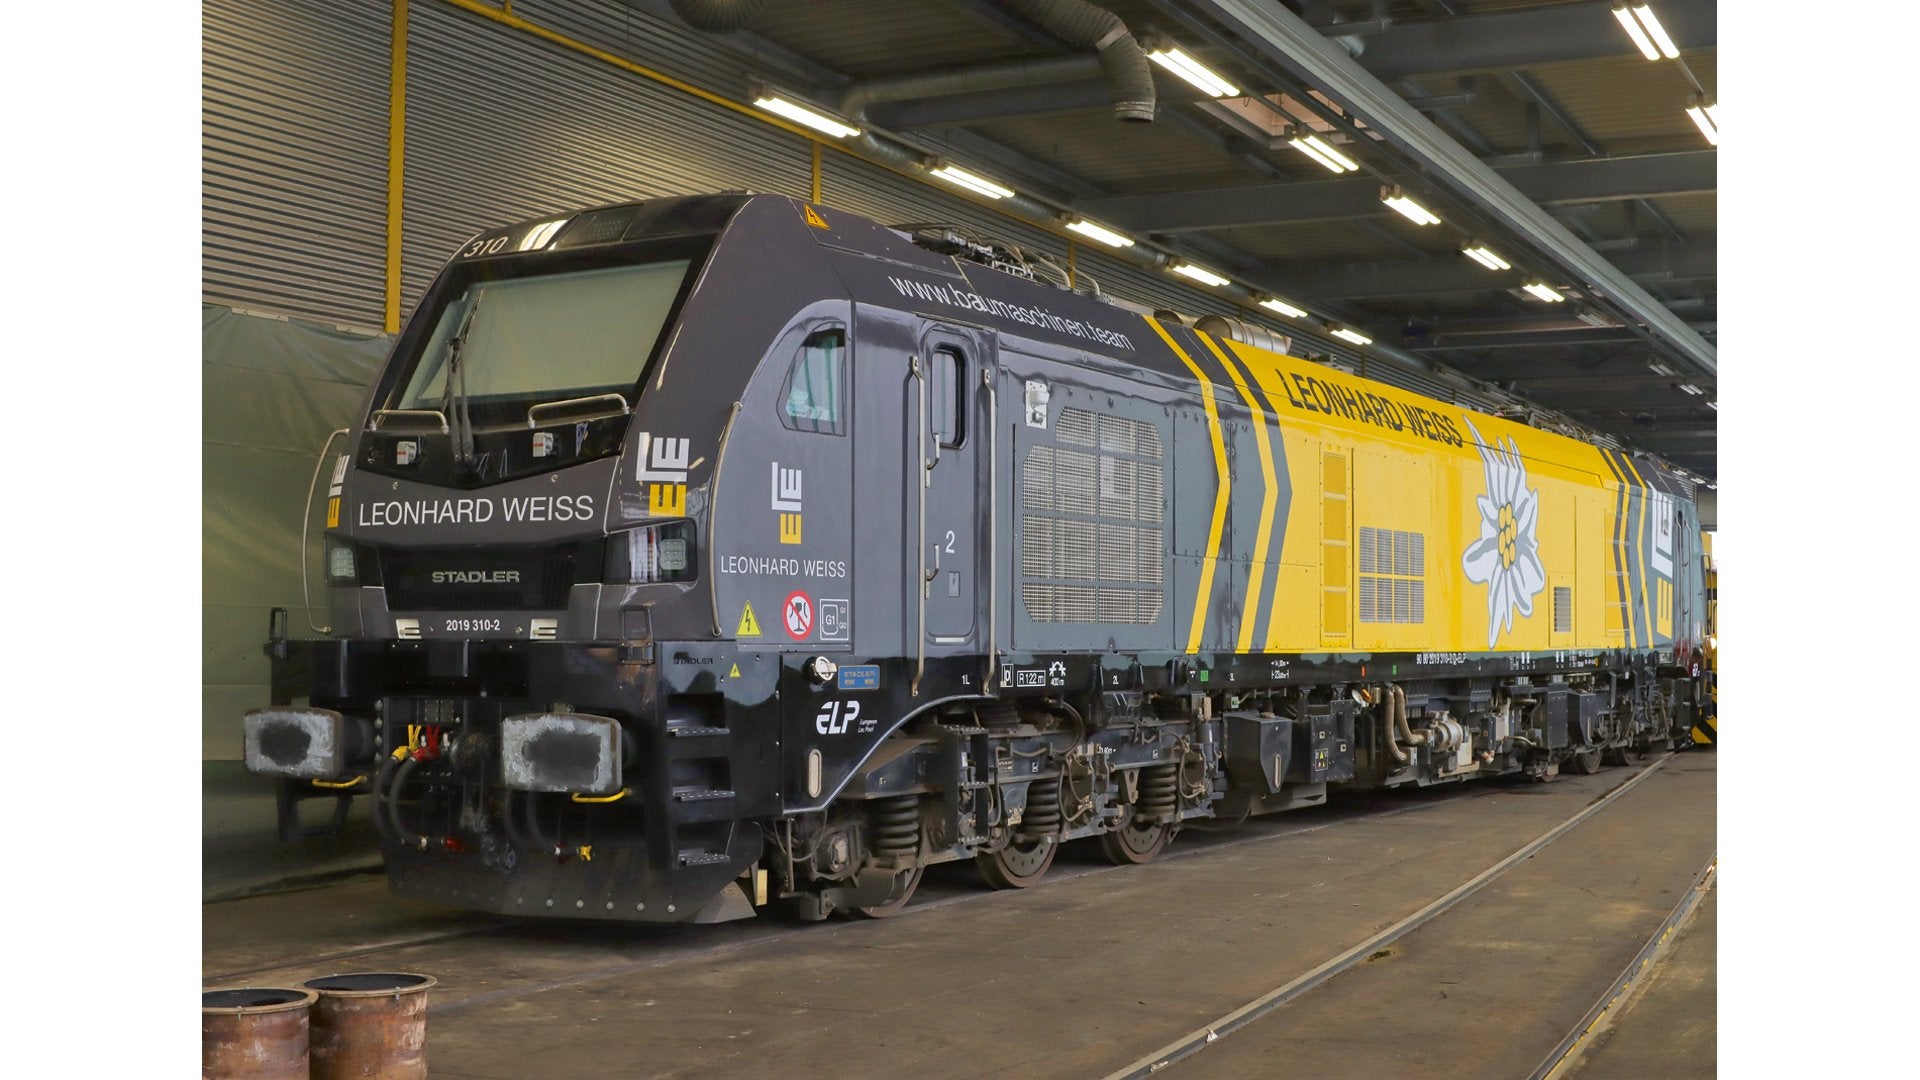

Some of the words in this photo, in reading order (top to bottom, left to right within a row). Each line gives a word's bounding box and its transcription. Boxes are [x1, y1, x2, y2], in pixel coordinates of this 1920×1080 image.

[464, 236, 509, 258] 310
[888, 275, 1136, 351] www.baumaschinen.team
[1275, 368, 1404, 432] LEONHARD
[1396, 401, 1463, 448] WEISS
[359, 498, 494, 526] LEONHARD
[502, 495, 594, 522] WEISS
[945, 530, 955, 554] 2
[431, 570, 520, 583] STADLER
[720, 555, 799, 576] LEONHARD
[803, 560, 846, 578] WEISS
[446, 619, 470, 631] 2019
[472, 619, 500, 631] 310-2
[825, 614, 835, 625] G1
[961, 674, 970, 685] 1L
[1019, 673, 1024, 684] R
[1026, 673, 1037, 684] 122
[816, 700, 860, 735] ELP
